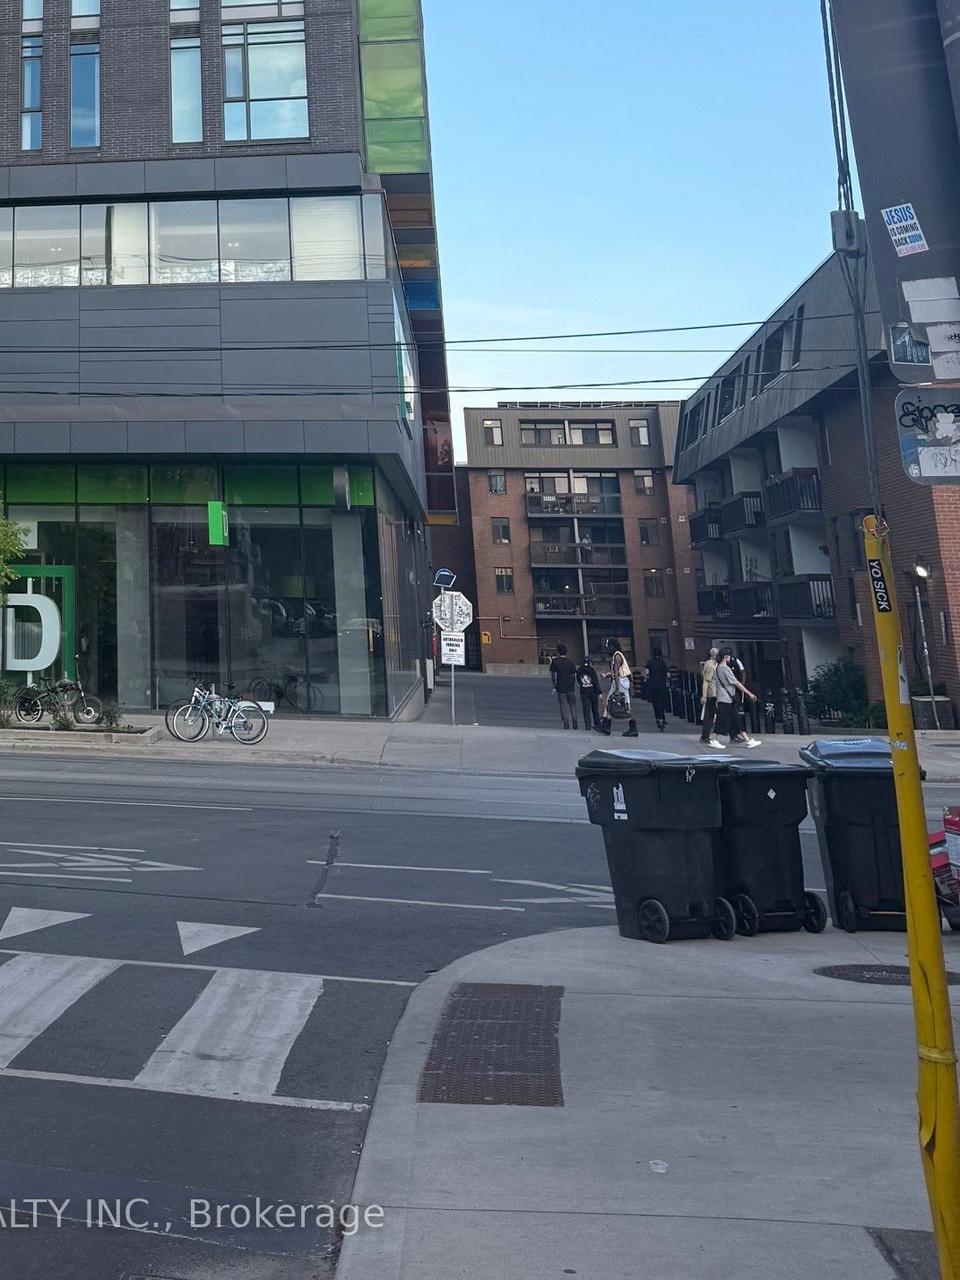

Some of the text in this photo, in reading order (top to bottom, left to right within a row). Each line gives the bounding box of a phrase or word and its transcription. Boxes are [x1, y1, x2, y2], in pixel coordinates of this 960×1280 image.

[885, 206, 914, 225] JESUS
[890, 222, 919, 237] IS COMING
[893, 236, 909, 248] BACK
[870, 561, 889, 610] YO SICK
